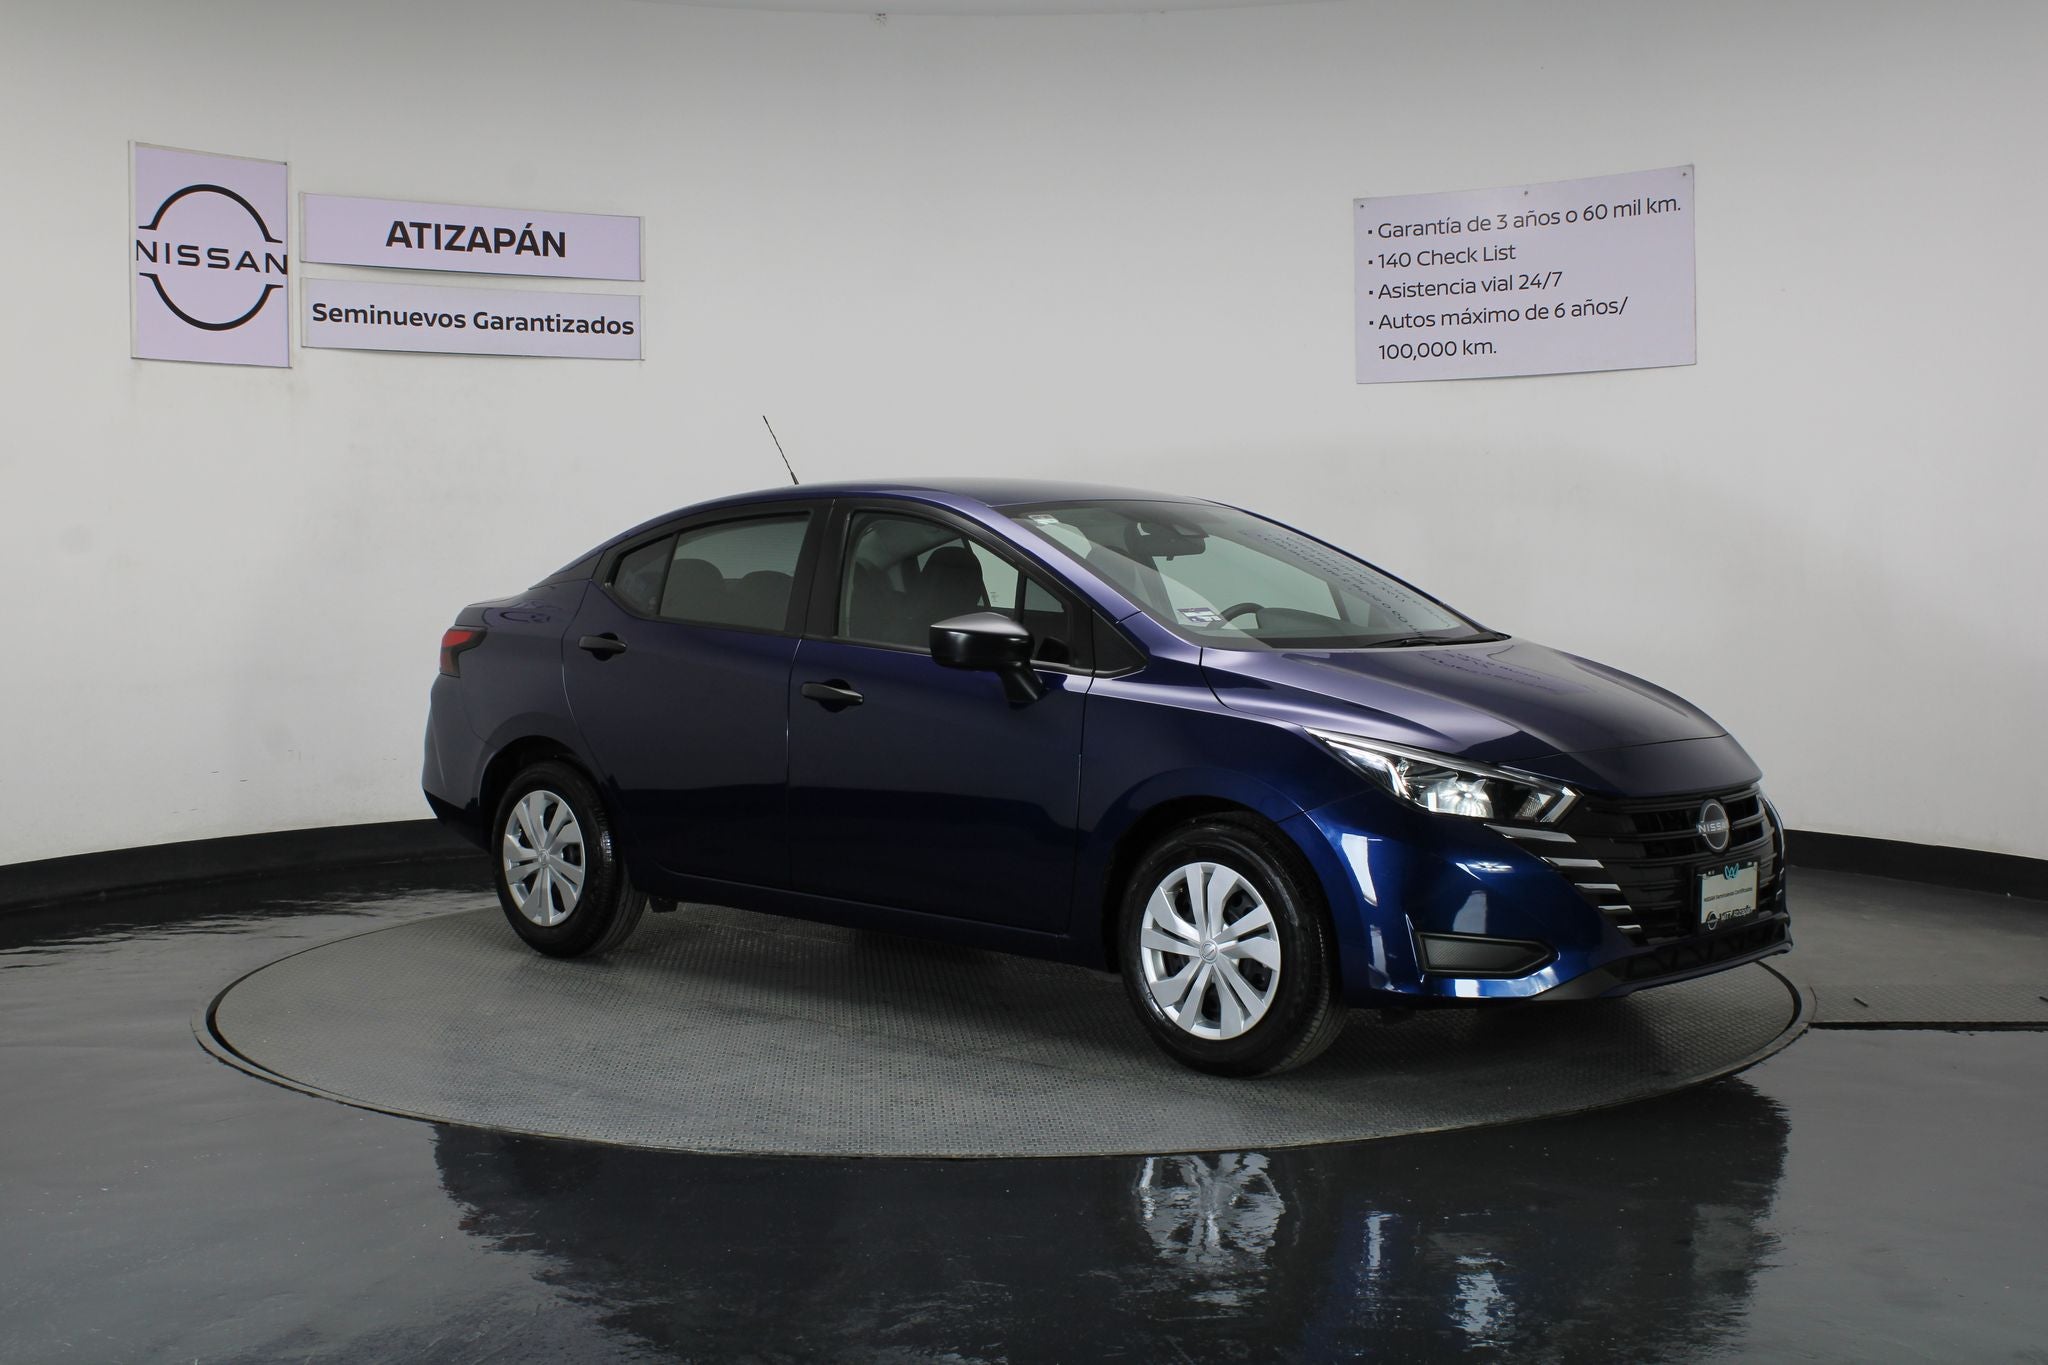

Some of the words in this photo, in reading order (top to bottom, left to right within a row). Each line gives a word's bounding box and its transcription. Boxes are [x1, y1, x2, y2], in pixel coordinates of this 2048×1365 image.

[1377, 217, 1461, 239] Garantía
[1467, 215, 1491, 233] de
[1496, 214, 1508, 230] 3
[1513, 210, 1561, 229] años
[1565, 210, 1578, 223] o
[1583, 203, 1608, 222] 60
[1613, 198, 1641, 218] mil
[1646, 197, 1682, 215] km.
[385, 220, 566, 258] ATIZAPÁN
[136, 239, 288, 275] NISSAN
[1378, 252, 1412, 269] 140
[1416, 247, 1478, 267] Check
[1483, 244, 1516, 262] List
[1378, 278, 1476, 300] Asistencia
[1481, 274, 1513, 293] vial
[1518, 271, 1563, 290] 24/7
[312, 302, 467, 329] Seminuevos
[473, 311, 635, 336] Garantizados
[1378, 313, 1436, 330] Autos
[1441, 307, 1520, 326] máximo
[1524, 303, 1549, 321] de
[1554, 302, 1566, 319] 6
[1571, 296, 1629, 317] años/
[1378, 340, 1457, 361] 100,000
[1463, 339, 1497, 356] km.
